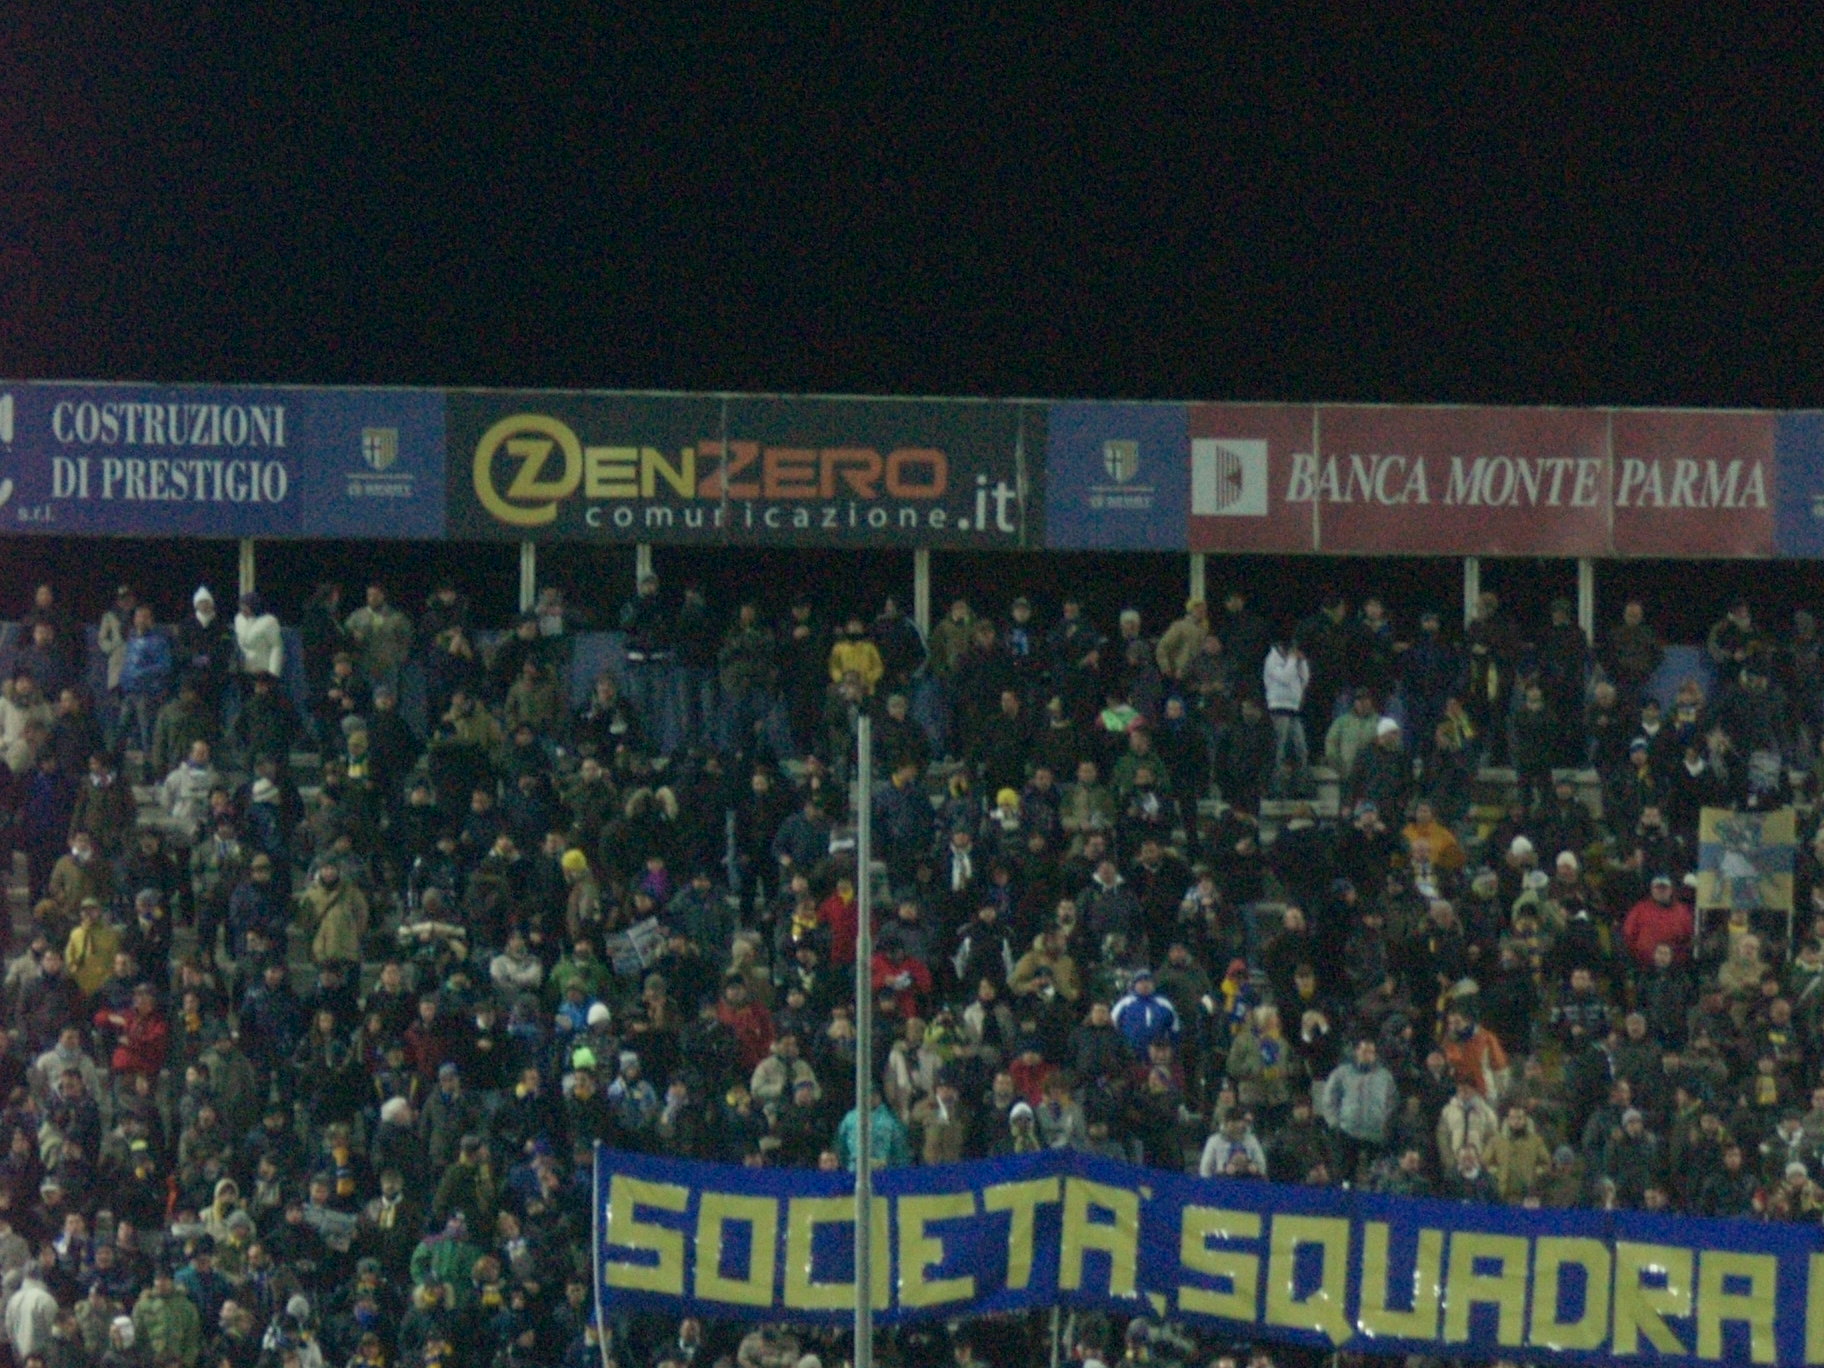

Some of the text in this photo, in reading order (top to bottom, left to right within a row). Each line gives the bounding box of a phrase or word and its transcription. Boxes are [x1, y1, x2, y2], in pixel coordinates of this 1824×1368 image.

[52, 401, 287, 447] COSTRUZIONI
[52, 456, 288, 503] DI PRESTIGIO
[1286, 454, 1770, 508] BANCA MONTE PARMA
[1179, 1204, 1777, 1365] SQUADRA
